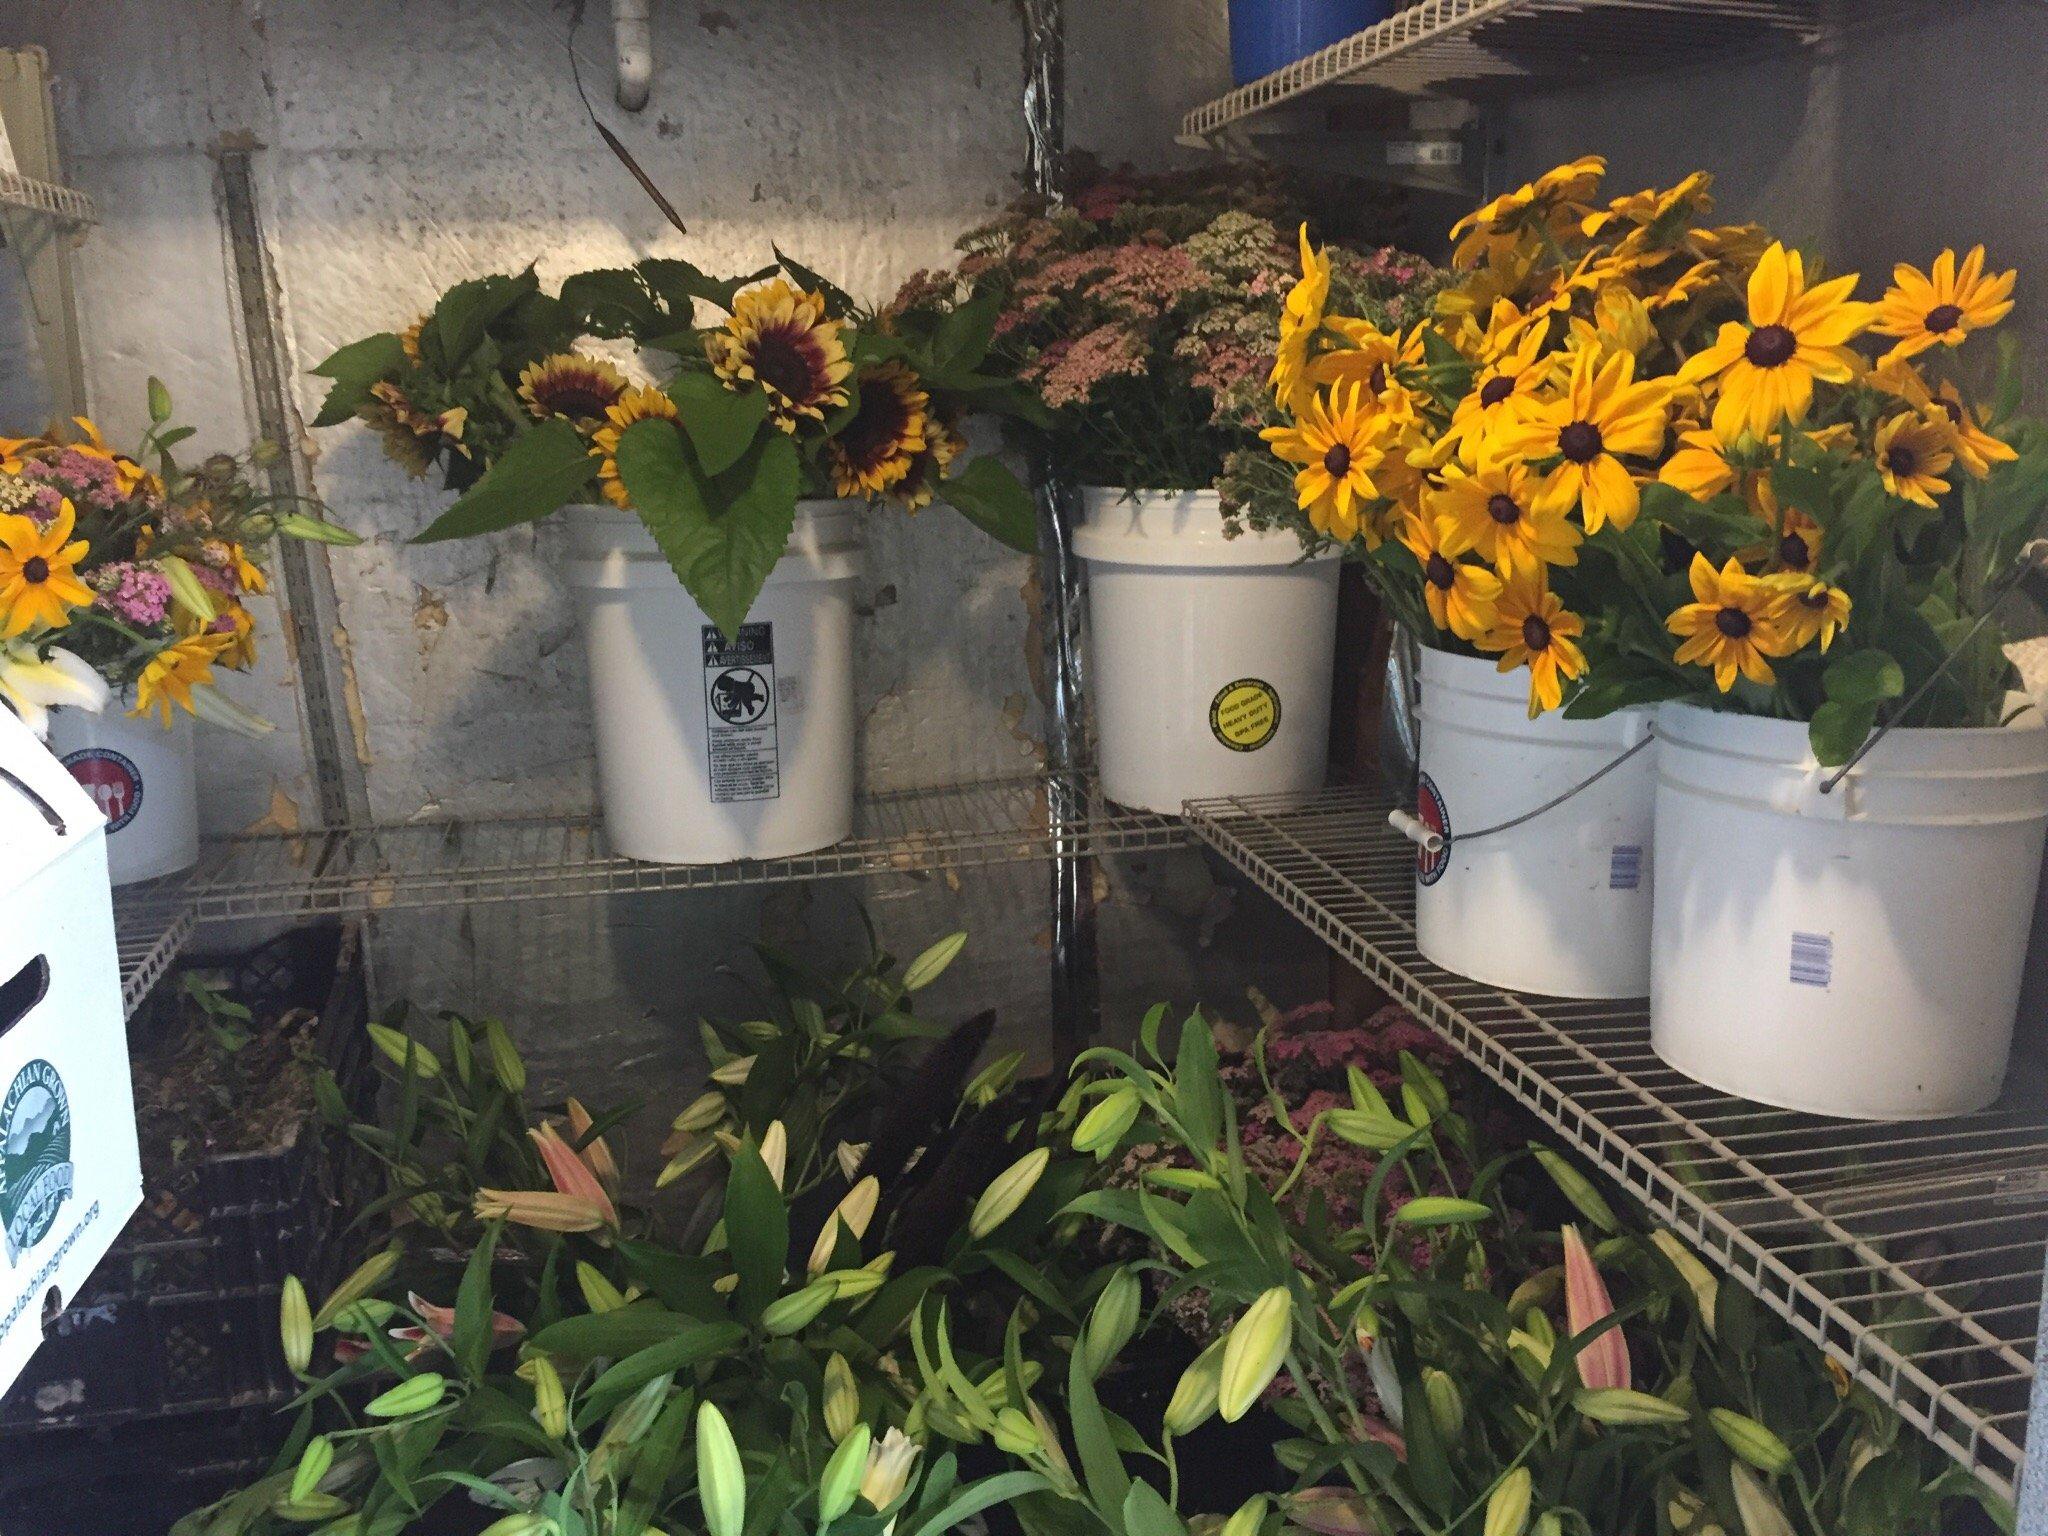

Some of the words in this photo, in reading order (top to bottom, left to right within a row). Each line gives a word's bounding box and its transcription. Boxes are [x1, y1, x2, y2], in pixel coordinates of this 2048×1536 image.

[1221, 703, 1239, 716] FOOD
[1241, 691, 1262, 706] GRADE
[1222, 713, 1247, 729] HEAVY
[1248, 701, 1268, 716] DUTY
[1250, 716, 1269, 730] FREE
[42, 1064, 70, 1128] GROWN
[8, 1184, 43, 1248] LOCAL
[43, 1164, 71, 1197] FOOD
